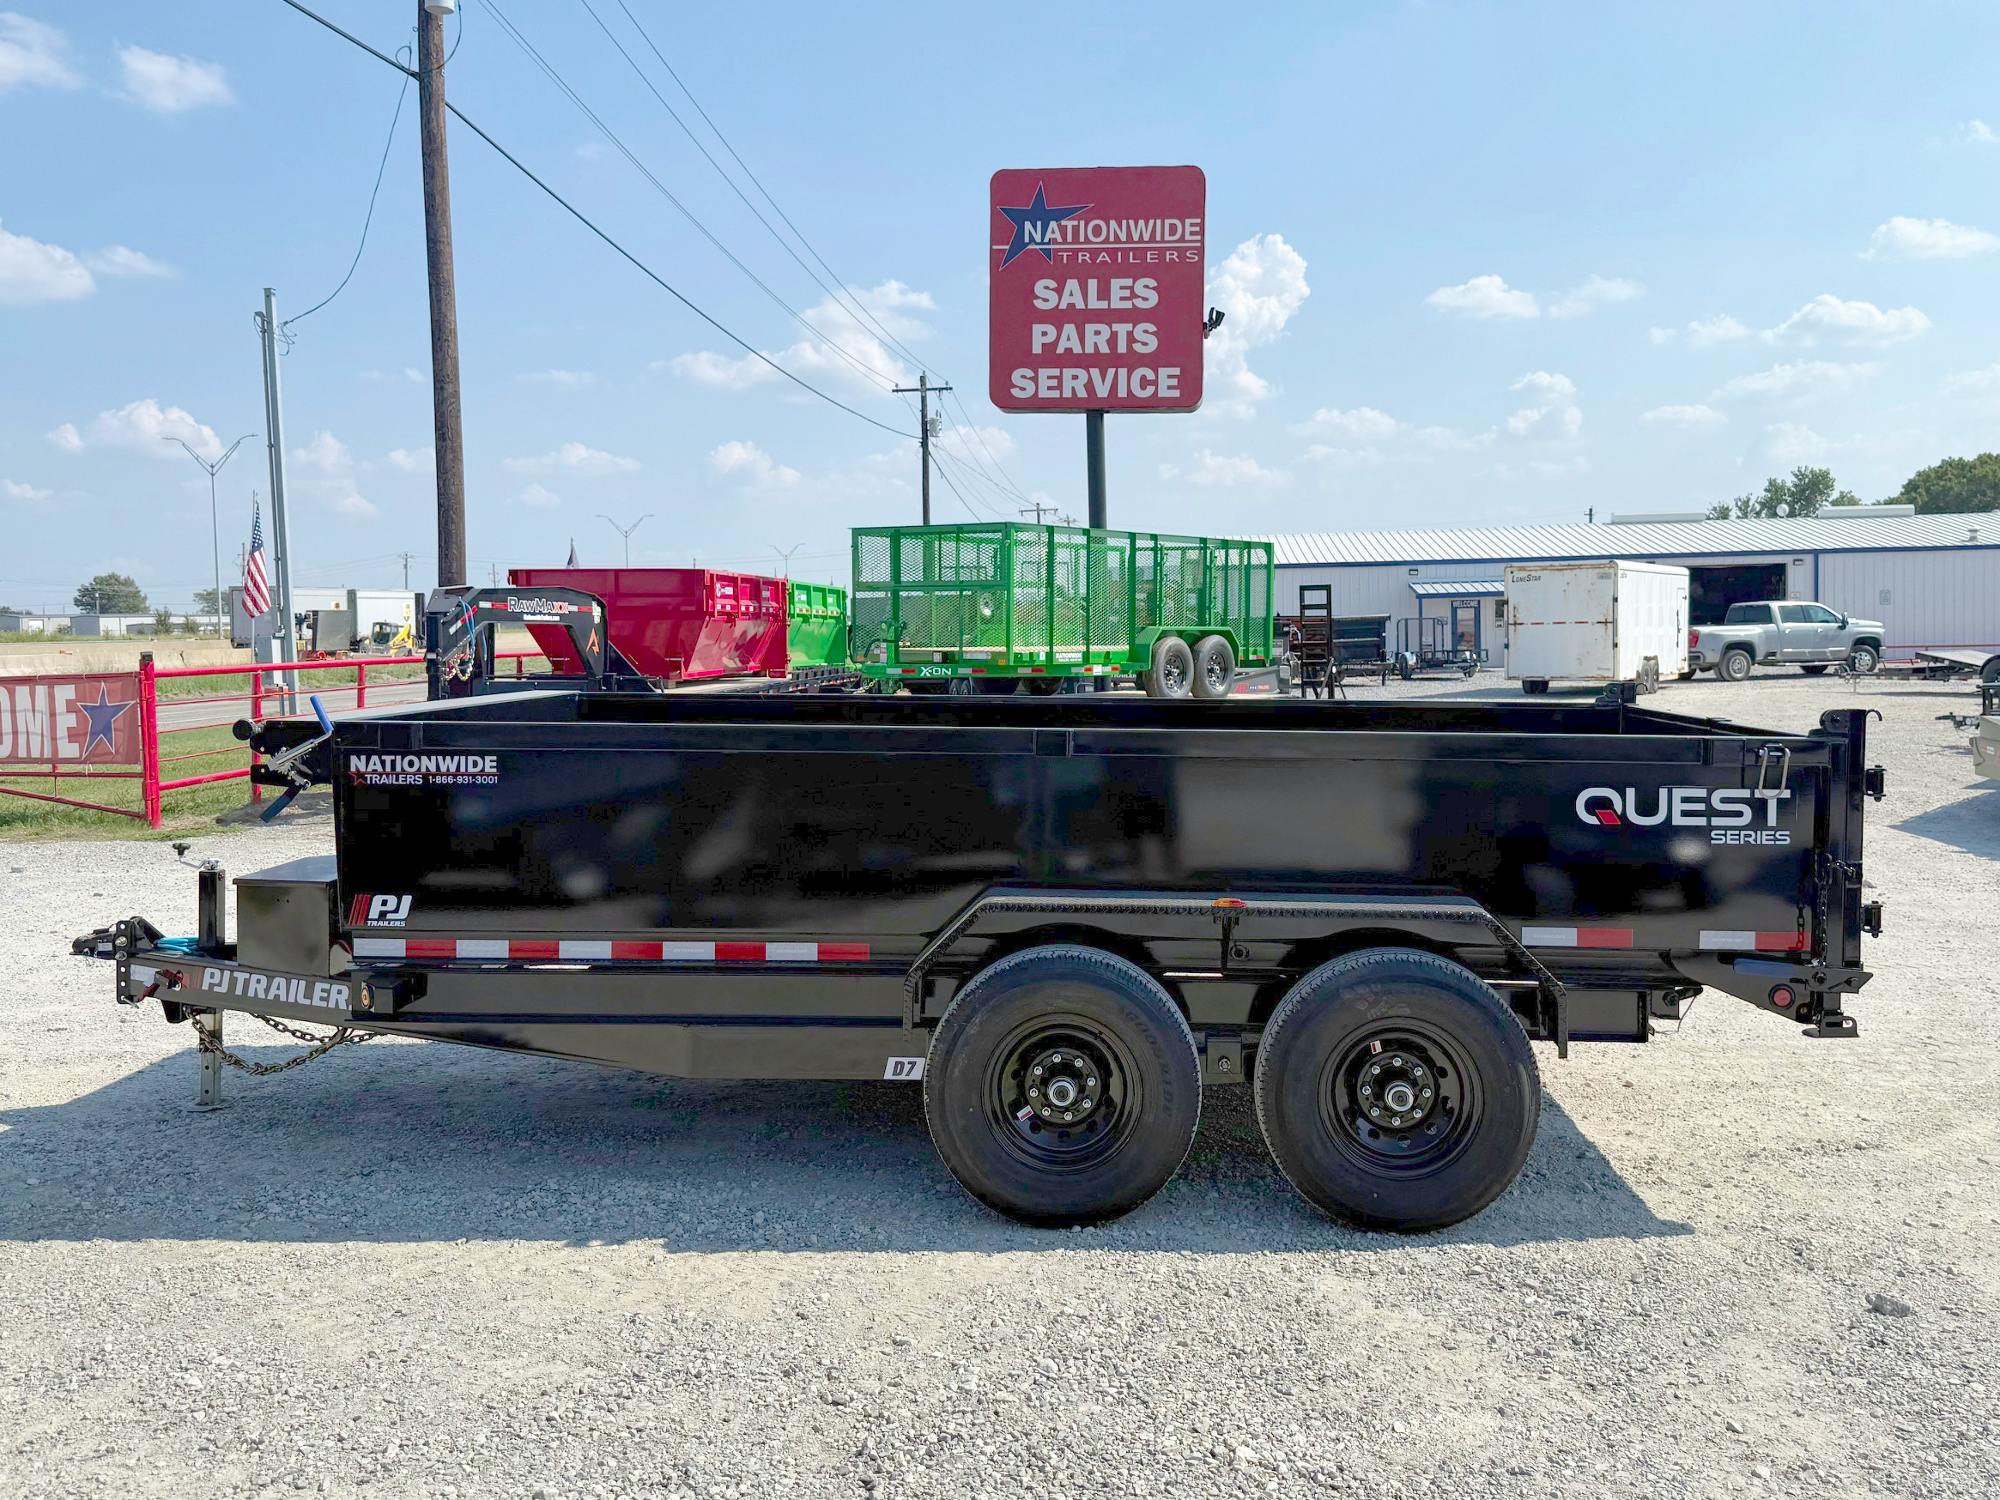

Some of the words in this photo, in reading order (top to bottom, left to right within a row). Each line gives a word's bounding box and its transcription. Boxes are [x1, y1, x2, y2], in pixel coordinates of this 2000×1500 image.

[1024, 218, 1201, 243] NATIONWIDE
[1058, 250, 1199, 264] TRAILERS
[1033, 278, 1159, 310] SALES
[1032, 323, 1159, 354] PARTS
[1010, 367, 1180, 399] SERVICE
[1452, 600, 1479, 608] WELCOME
[350, 755, 498, 773] NATIONWIDE
[365, 774, 423, 785] TRAILERS
[428, 775, 498, 784] 1-866-931-3001
[1575, 787, 1791, 827] QUEST
[1710, 830, 1791, 845] SERIES
[368, 894, 412, 919] PJ
[202, 967, 231, 993] PJ
[233, 971, 352, 1011] TRAILER
[892, 1060, 917, 1077] D7
